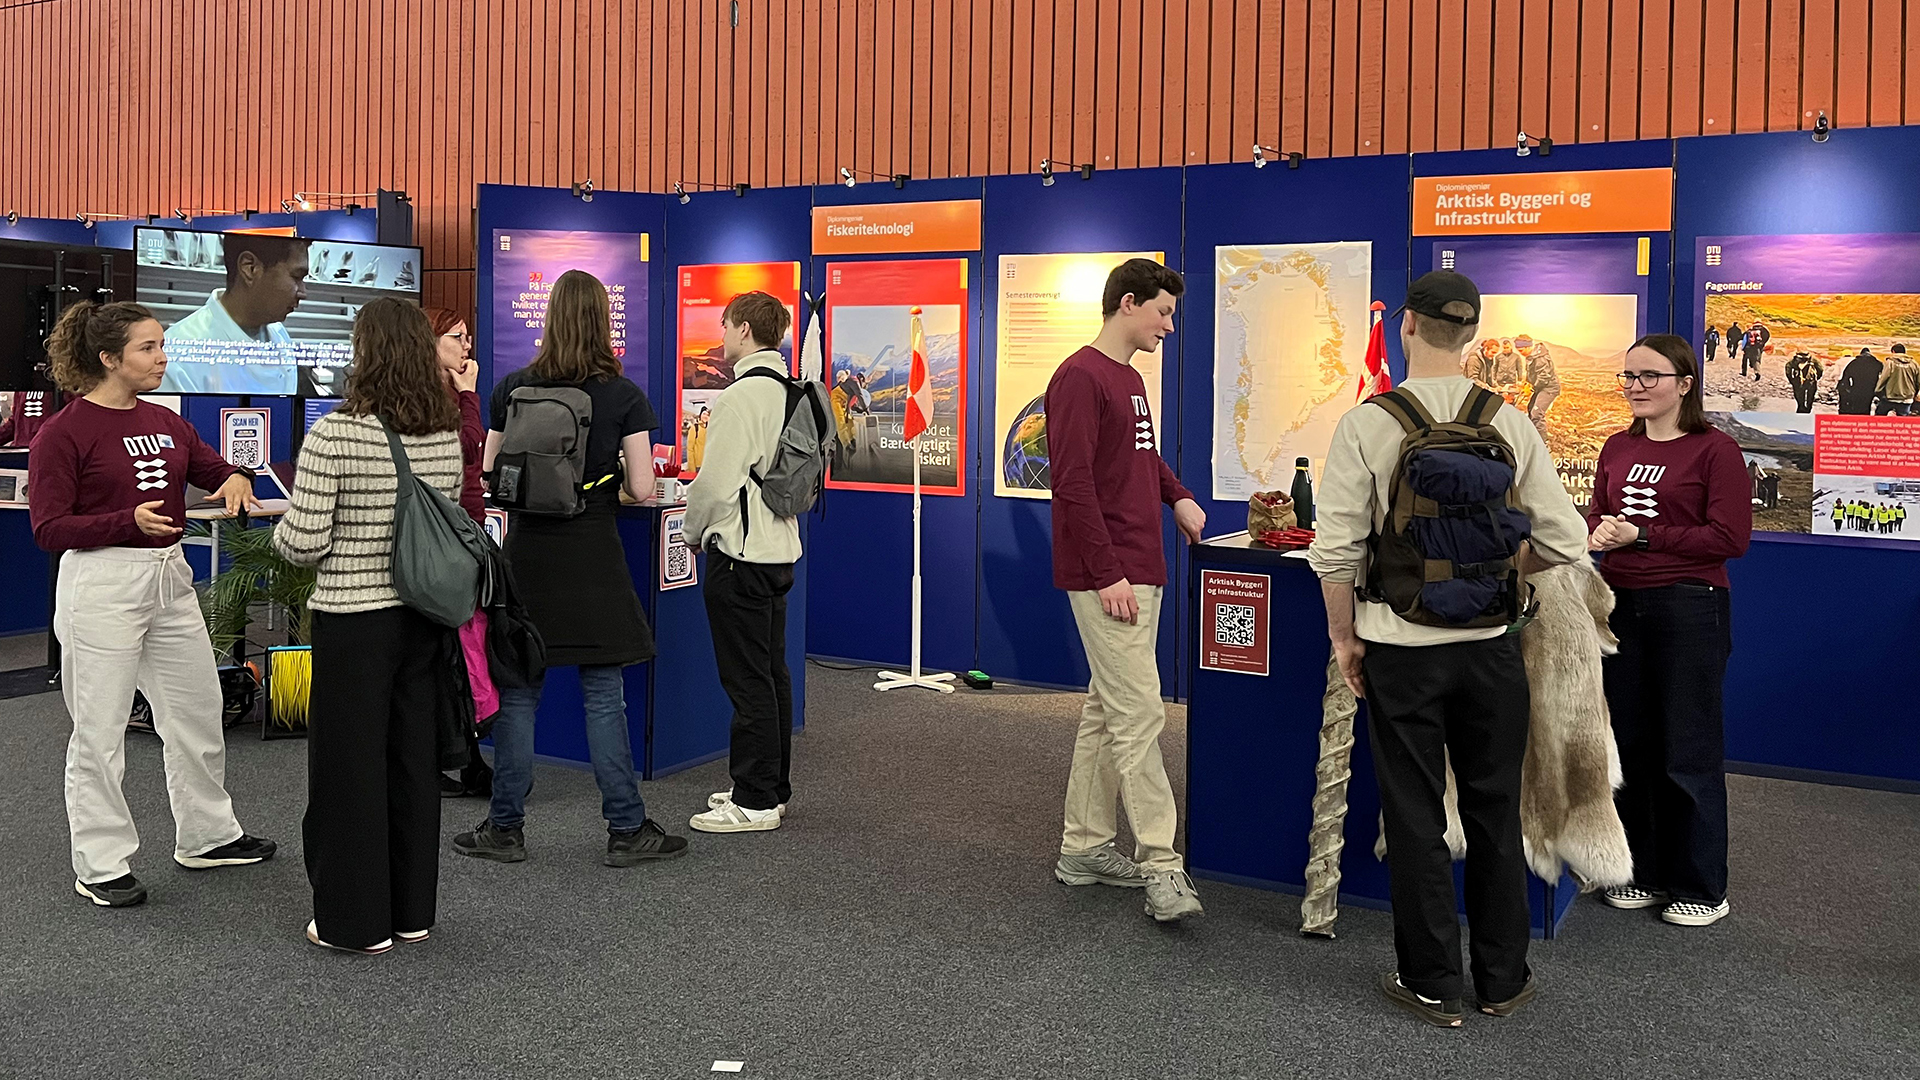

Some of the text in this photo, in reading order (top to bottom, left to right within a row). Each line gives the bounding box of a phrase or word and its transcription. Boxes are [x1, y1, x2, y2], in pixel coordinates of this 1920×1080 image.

[1435, 183, 1491, 192] Diplomingeniør
[1435, 191, 1592, 210] Arktisk Byggeri og
[1435, 210, 1542, 226] Infrastruktur
[827, 221, 914, 237] Fiskeriteknologi
[148, 238, 163, 248] DTU
[1442, 250, 1455, 259] DTU
[1706, 245, 1721, 255] DTU
[529, 282, 540, 291] På
[612, 284, 625, 293] der
[1705, 280, 1764, 293] Fagområder
[1006, 291, 1061, 299] Semesteroversigt
[511, 300, 539, 309] hvilket
[614, 302, 625, 311] får
[514, 311, 532, 319] man
[525, 319, 540, 328] det
[613, 321, 626, 329] lov
[610, 339, 626, 347] den
[179, 355, 216, 365] omkring
[246, 356, 280, 365] hvordan
[232, 417, 259, 427] SCAN HER
[891, 423, 904, 435] Ku
[939, 425, 951, 436] et
[122, 434, 161, 457] DTU
[919, 453, 951, 466] iskeri
[1553, 457, 1599, 473] øsnin
[1625, 463, 1667, 484] DTU
[1560, 472, 1596, 489] Arkt
[668, 520, 679, 531] SCAN
[1208, 577, 1263, 589] Arktisk Byggeri
[1207, 588, 1265, 599] og Infrastruktur
